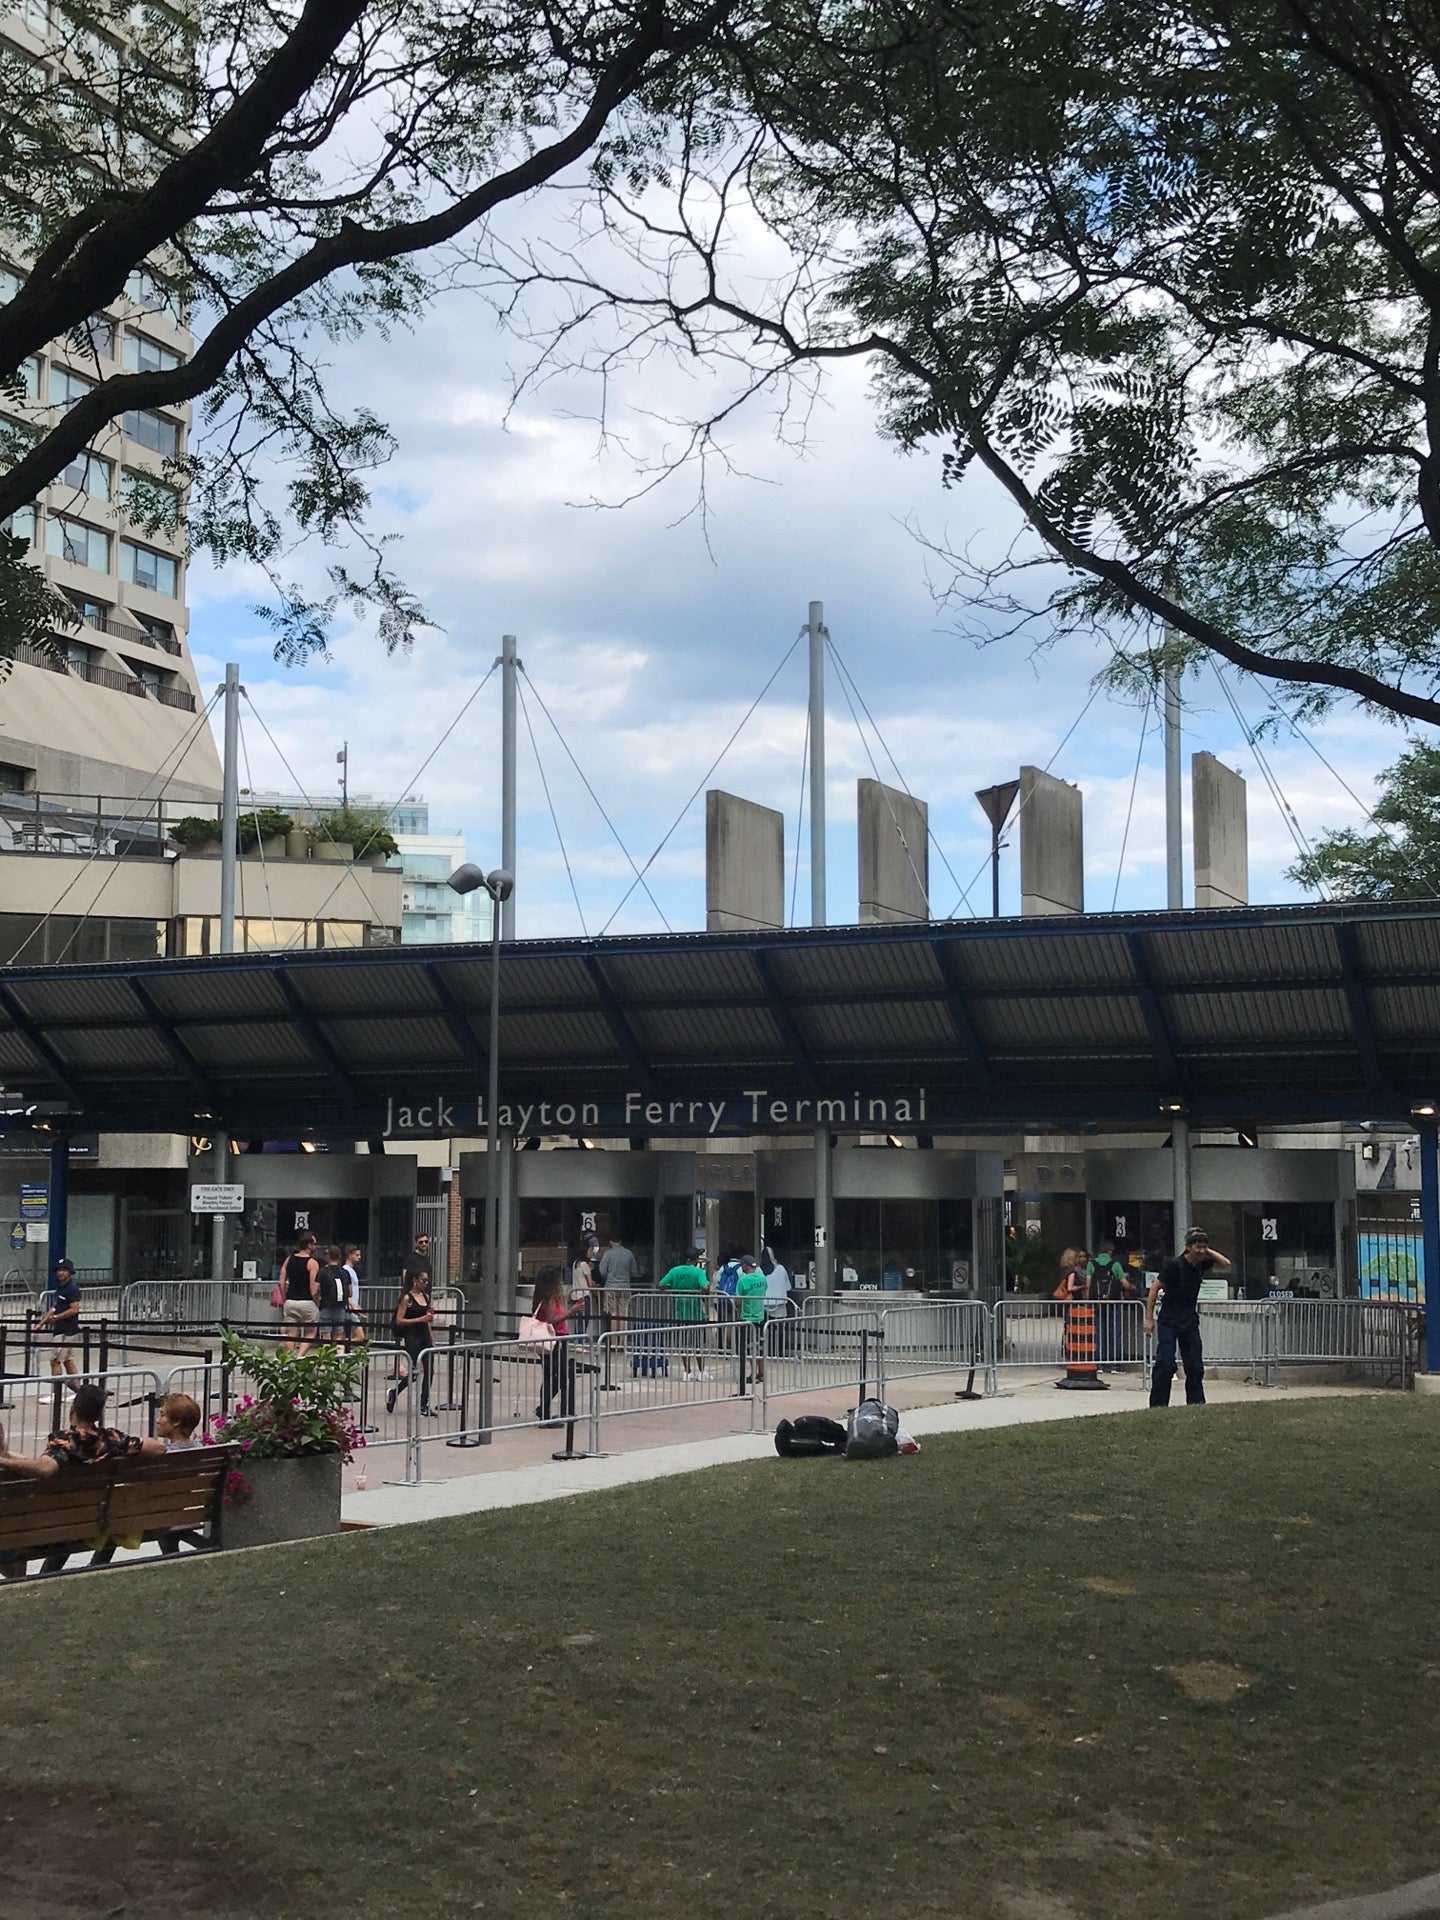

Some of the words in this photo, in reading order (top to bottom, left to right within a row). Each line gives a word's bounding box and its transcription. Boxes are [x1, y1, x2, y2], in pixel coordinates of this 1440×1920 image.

[382, 1096, 455, 1137] Jack
[477, 1095, 599, 1135] Layton
[624, 1092, 726, 1133] Ferry
[743, 1088, 926, 1124] Terminal
[296, 1215, 306, 1229] 8
[585, 1217, 593, 1231] 6
[1117, 1221, 1125, 1236] 3
[814, 1231, 820, 1246] 4
[1264, 1224, 1274, 1239] 2
[859, 1283, 878, 1291] OPEN
[1269, 1290, 1294, 1299] CLOSED
